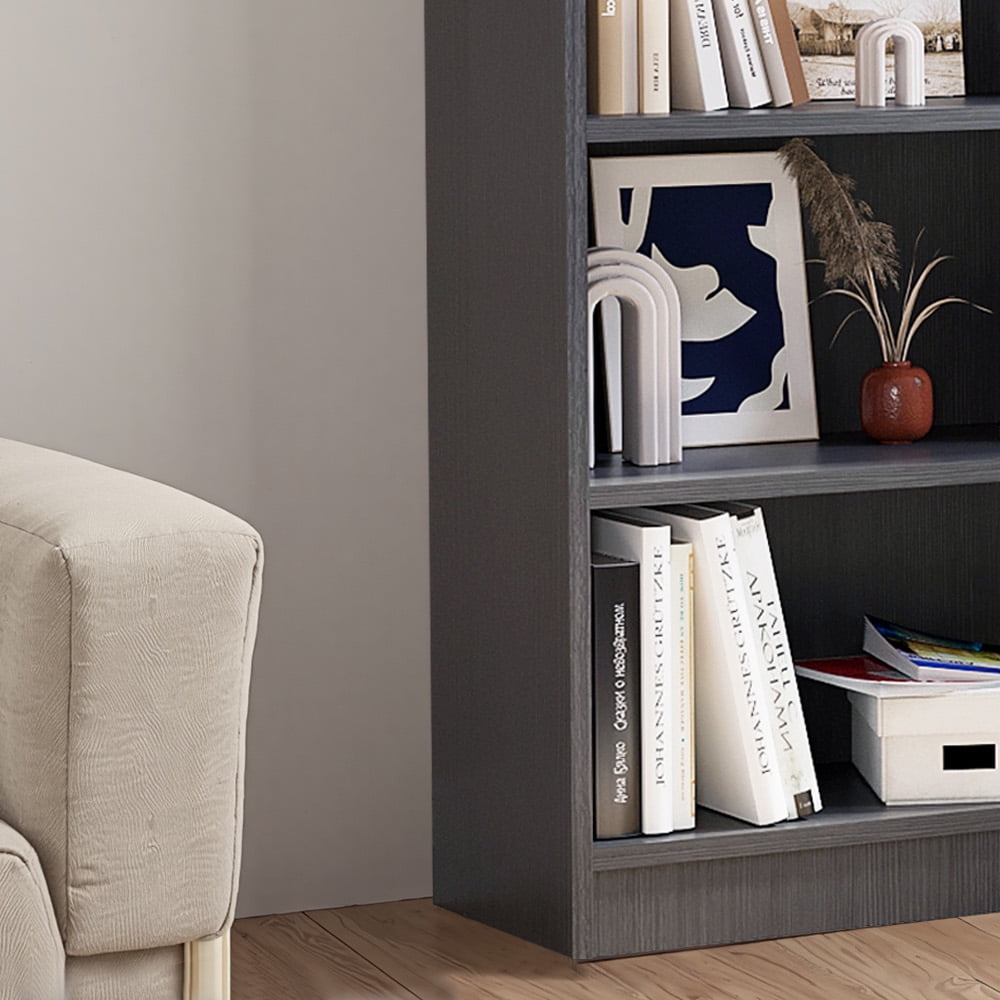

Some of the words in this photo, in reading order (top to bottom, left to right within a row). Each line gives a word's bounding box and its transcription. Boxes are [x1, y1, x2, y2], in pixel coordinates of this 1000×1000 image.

[613, 690, 628, 731] Сказки
[655, 661, 665, 785] JOHANNES
[738, 652, 770, 774] JOHANNES
[614, 777, 628, 803] Анна
